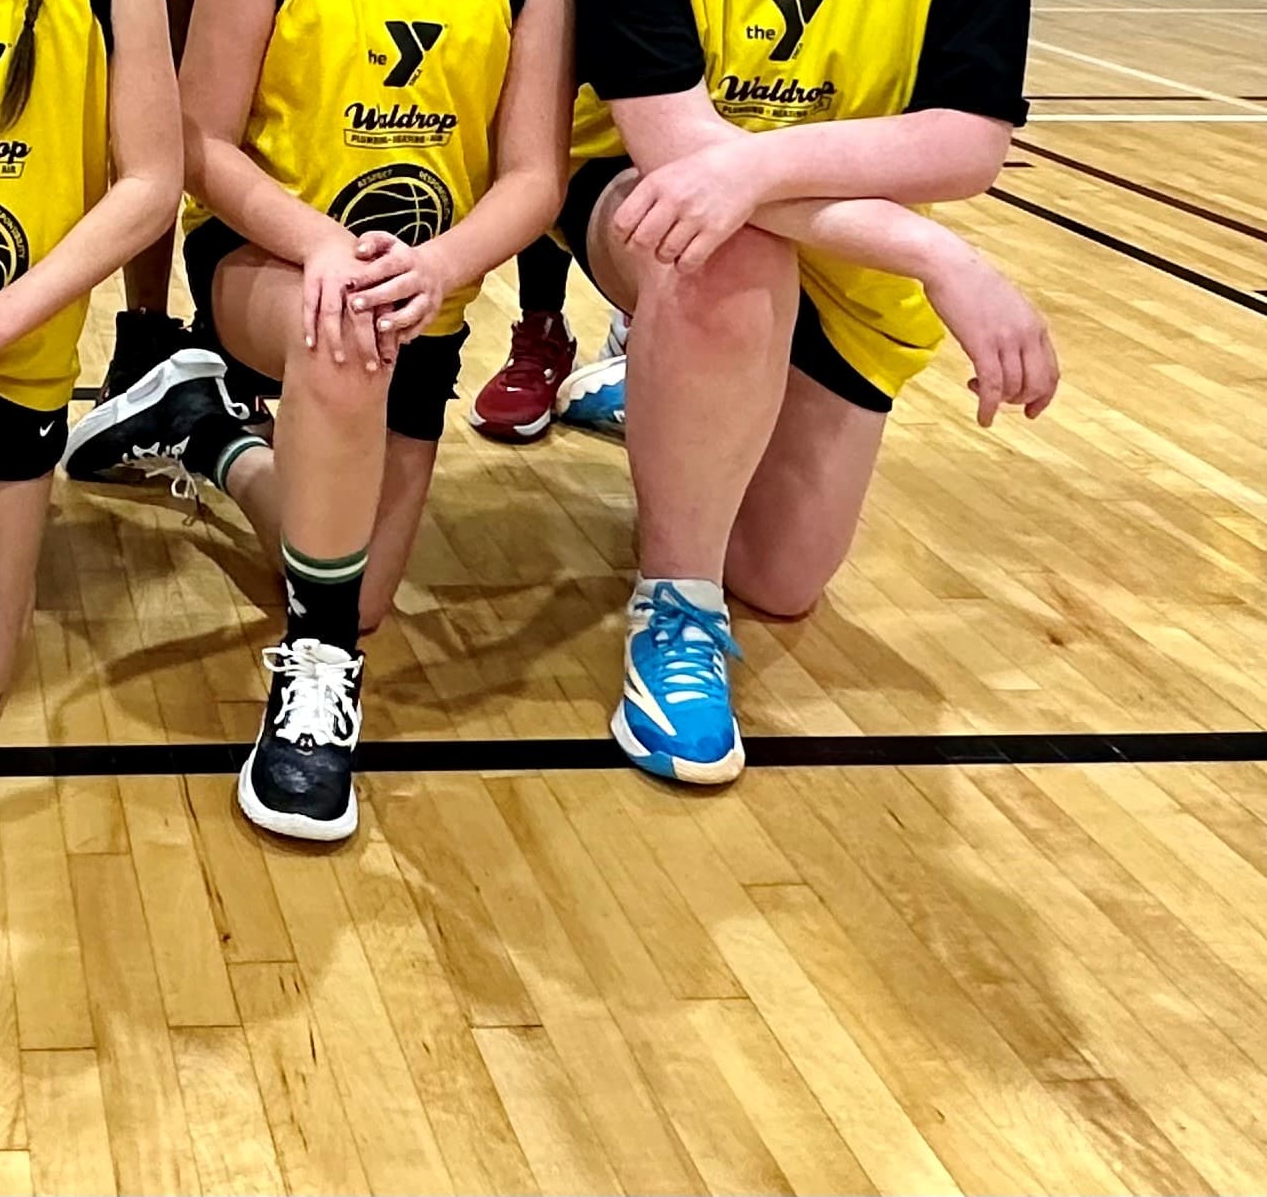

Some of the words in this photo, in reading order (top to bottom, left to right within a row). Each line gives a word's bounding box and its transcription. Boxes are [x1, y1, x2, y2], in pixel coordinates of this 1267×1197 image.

[746, 25, 776, 40] the
[368, 50, 387, 65] he
[717, 75, 837, 103] Waldrop
[344, 102, 459, 133] Waldrop
